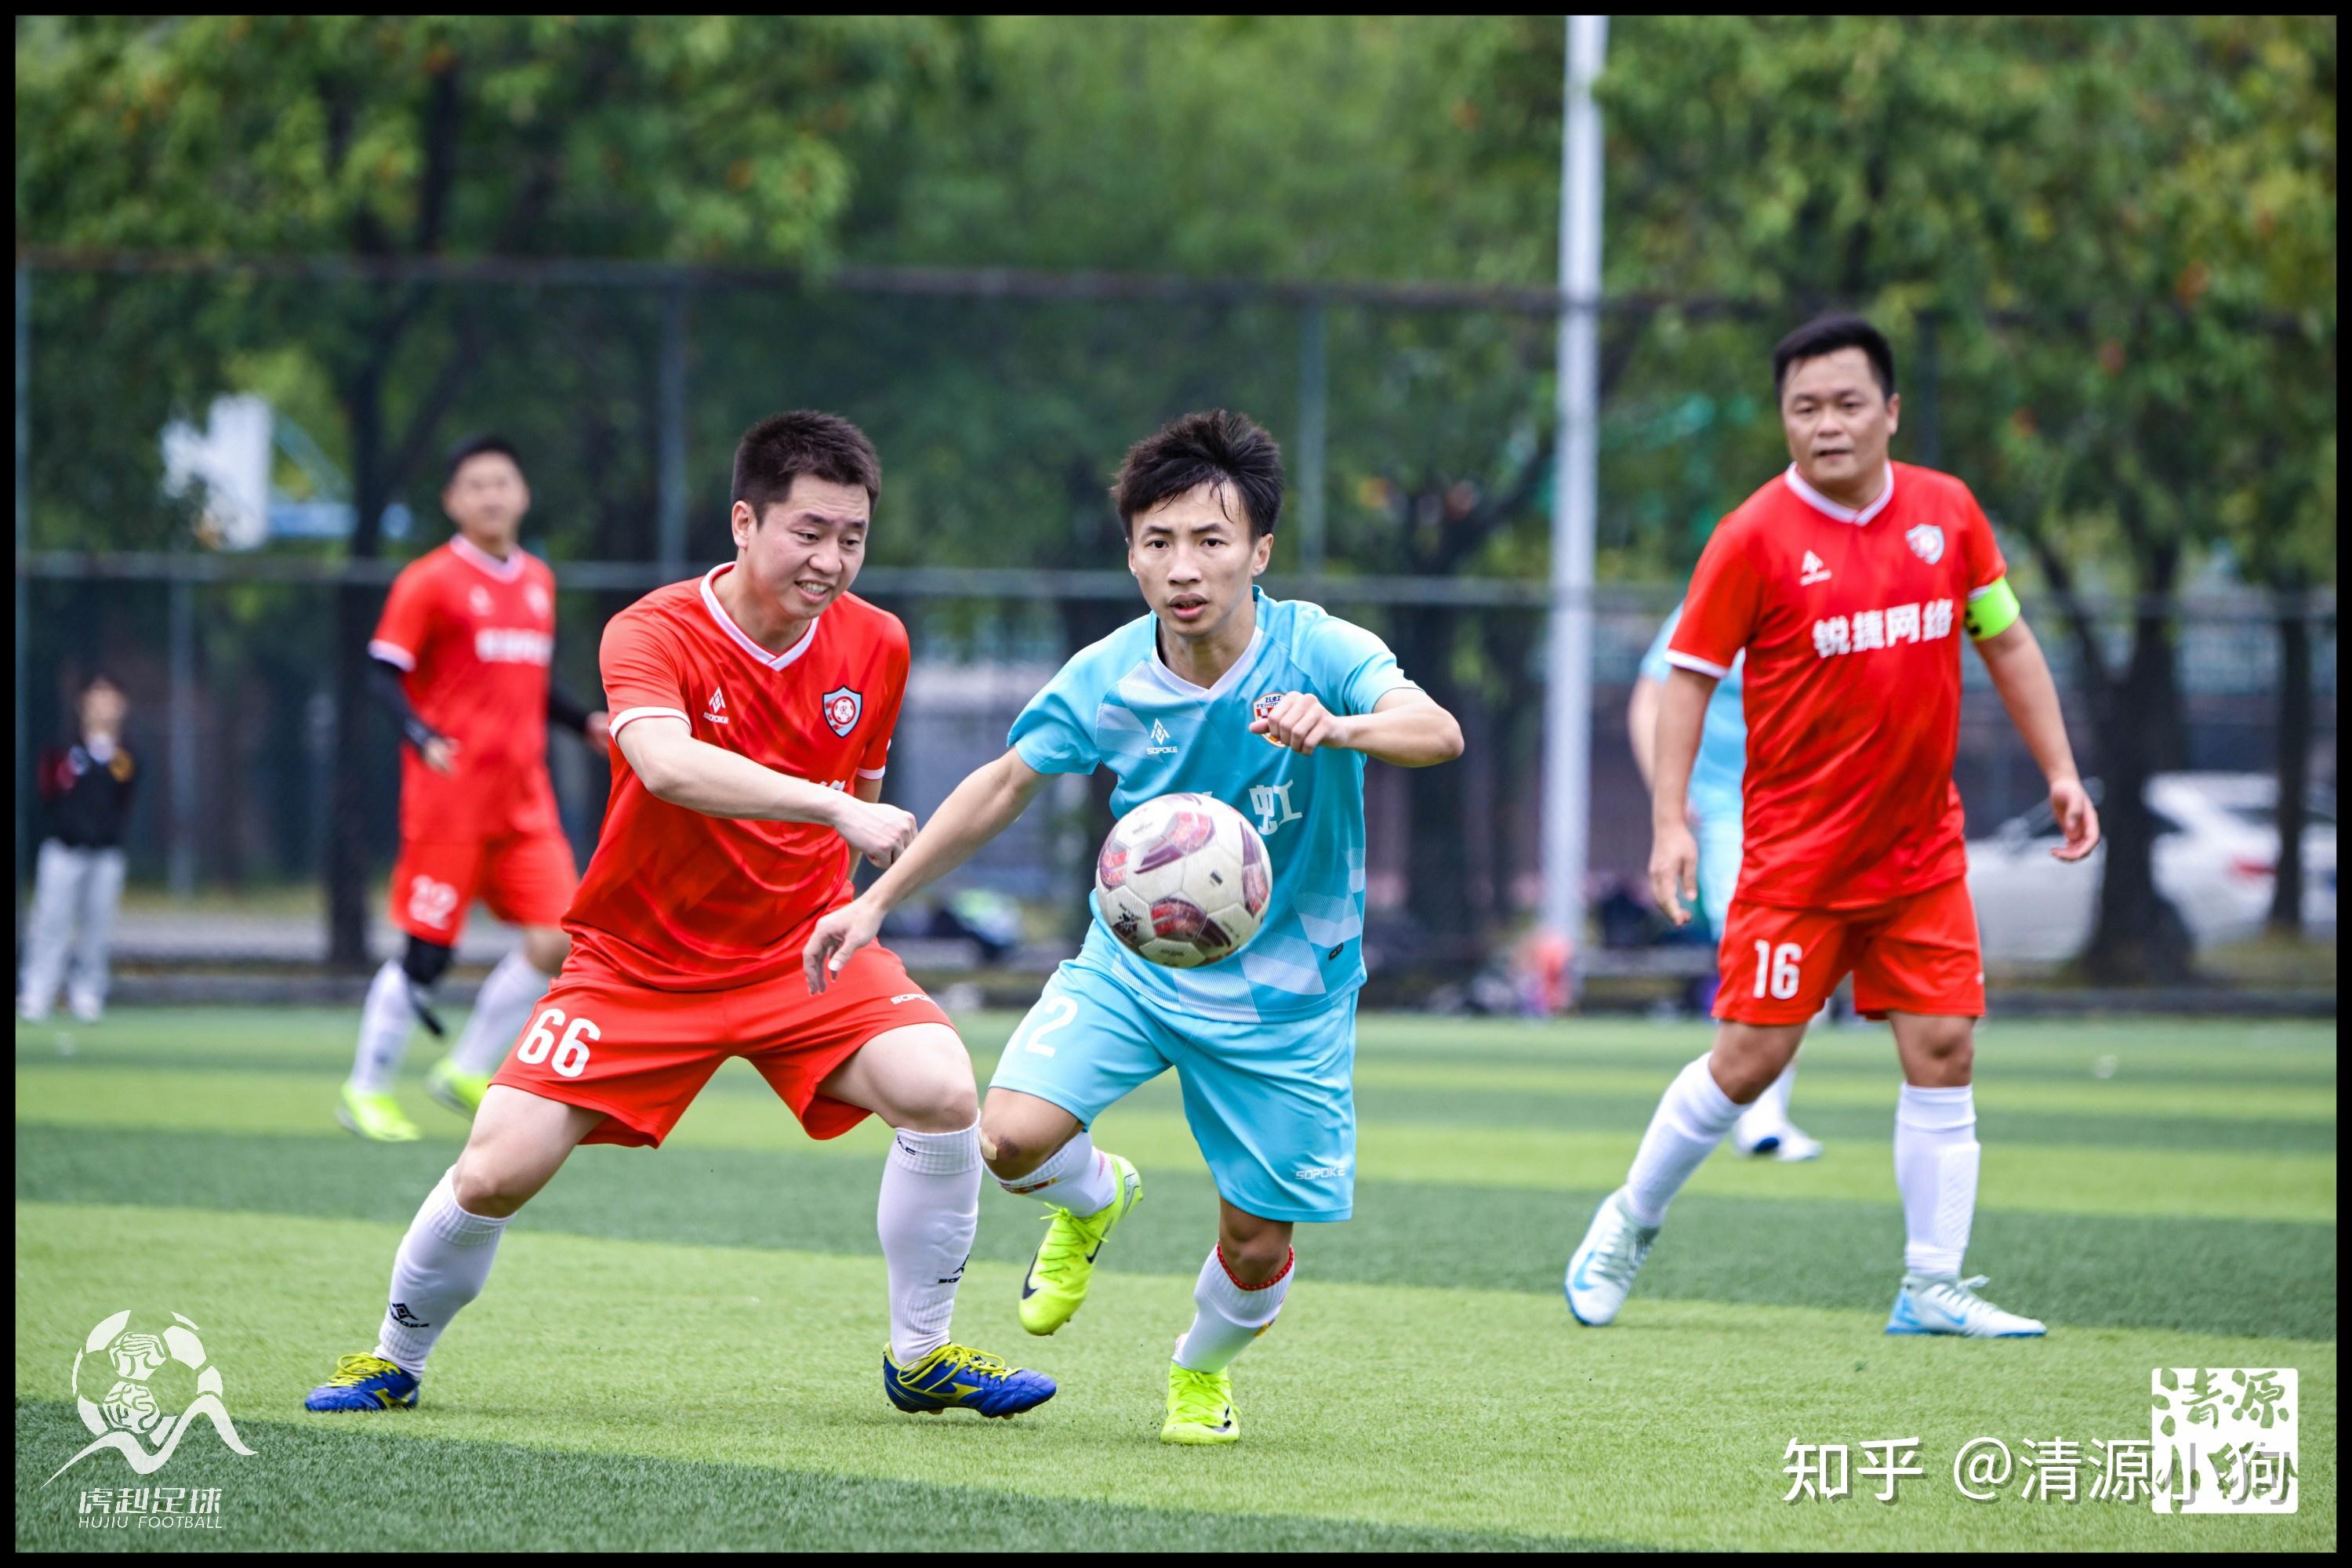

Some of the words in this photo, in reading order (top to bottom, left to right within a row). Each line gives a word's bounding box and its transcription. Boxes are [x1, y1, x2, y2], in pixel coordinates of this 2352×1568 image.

[1813, 598, 1954, 659] 锐捷网络
[1147, 746, 1178, 755] SOPOKE
[1248, 779, 1303, 836] 虹
[1753, 939, 1802, 1000] 16
[517, 1008, 601, 1077] 66
[1295, 1166, 1345, 1180] SOPOKE
